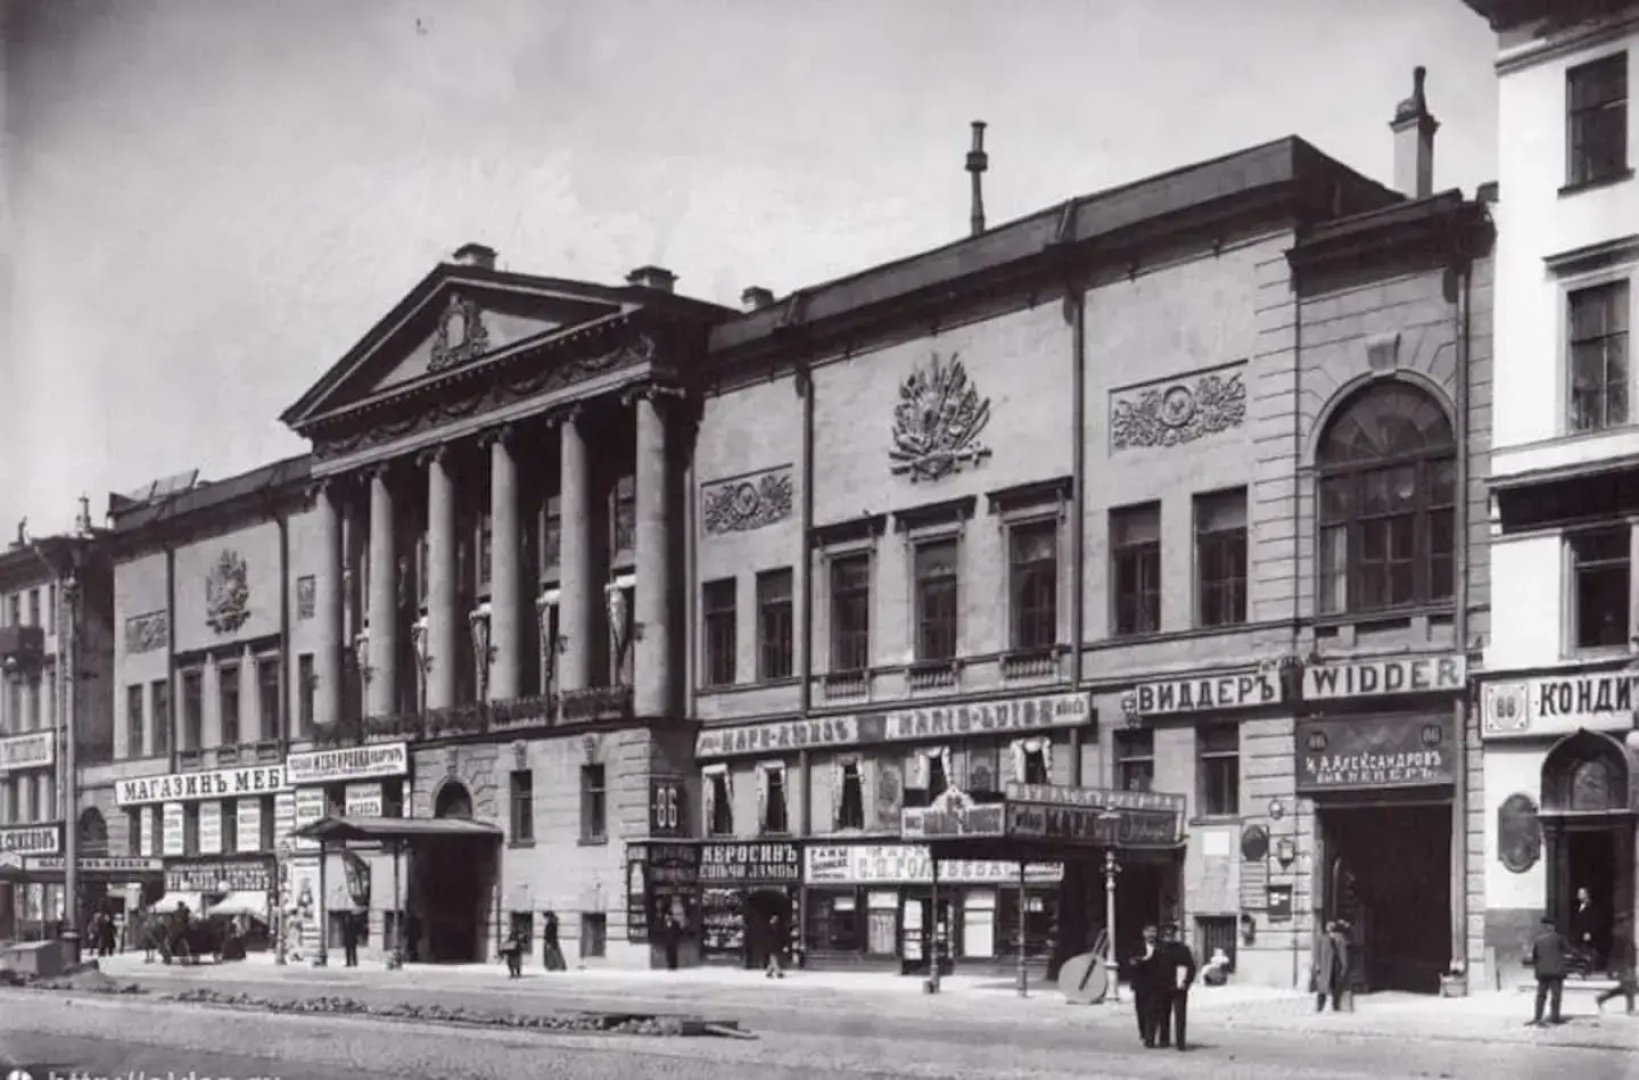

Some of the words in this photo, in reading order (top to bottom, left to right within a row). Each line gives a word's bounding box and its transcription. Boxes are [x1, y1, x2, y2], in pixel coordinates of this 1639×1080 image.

[1138, 675, 1275, 712] ВИДДЕРЪ
[1312, 658, 1459, 694] WIDDER
[124, 772, 228, 800] МАГАЗИНЪ
[235, 768, 281, 792] МЕБ
